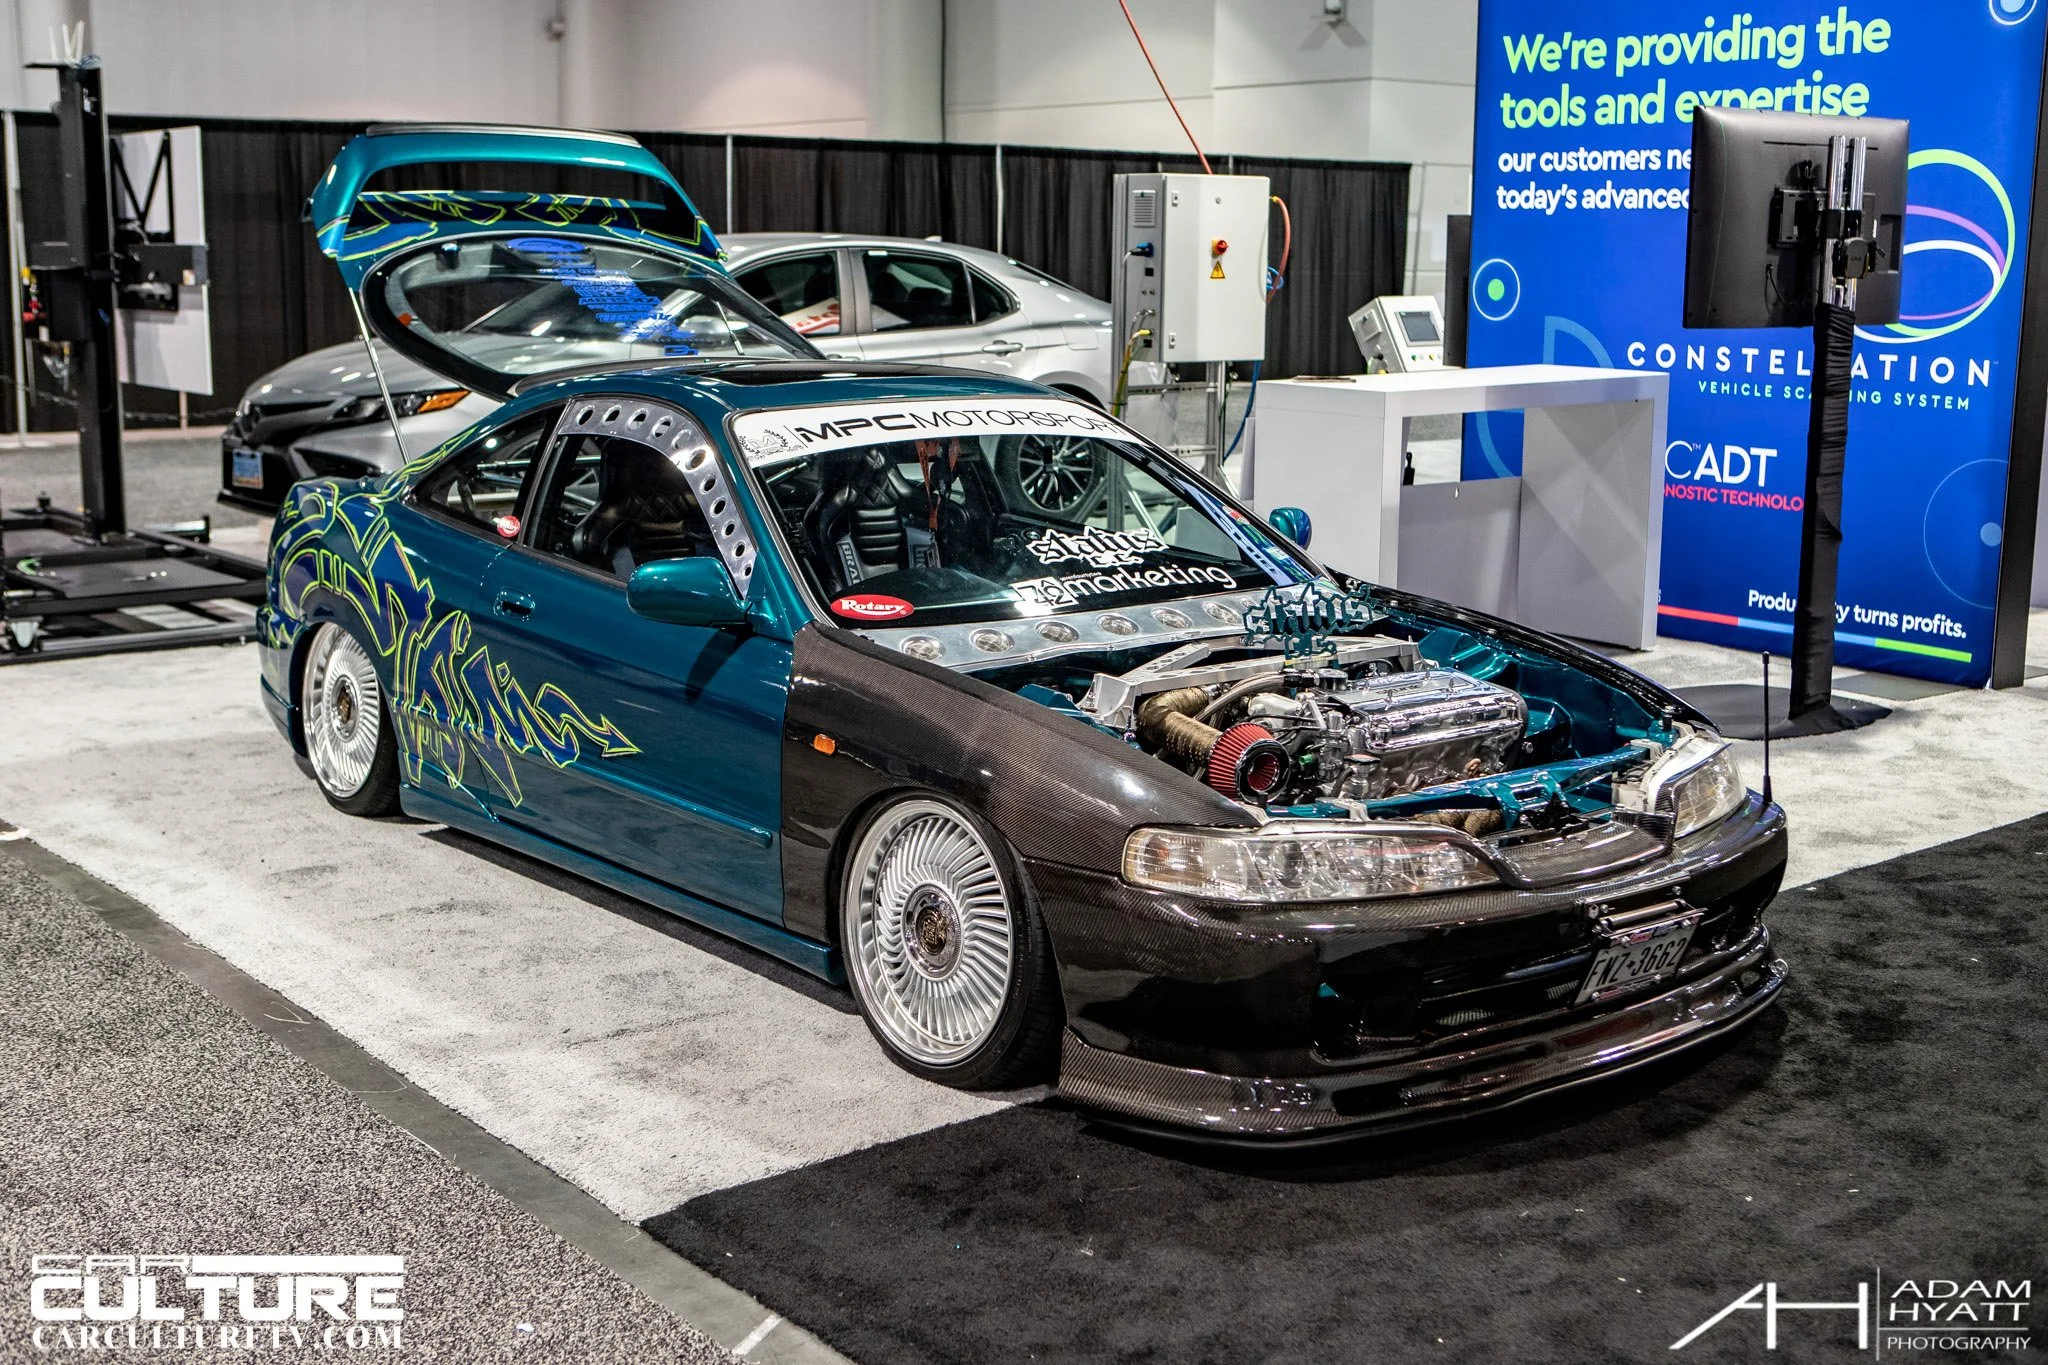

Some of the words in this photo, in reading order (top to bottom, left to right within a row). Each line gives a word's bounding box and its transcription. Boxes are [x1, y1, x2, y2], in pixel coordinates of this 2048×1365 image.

[1502, 31, 1608, 75] We're
[1615, 12, 1806, 78] providing
[1815, 5, 1893, 57] the
[1499, 82, 1587, 129] tools
[1593, 77, 1667, 126] and
[1497, 152, 1537, 173] our
[1539, 146, 1663, 173] customers
[1496, 180, 1578, 216] today's
[1626, 341, 1990, 388] CONSTELATION
[1698, 380, 1773, 398] VEHICLE
[1893, 391, 1970, 411] SYSTEM
[795, 413, 917, 444] MPC
[1064, 563, 1238, 598] marketing
[840, 599, 905, 616] Rotary
[1853, 604, 1898, 628] turns
[1901, 613, 1968, 639] profits.
